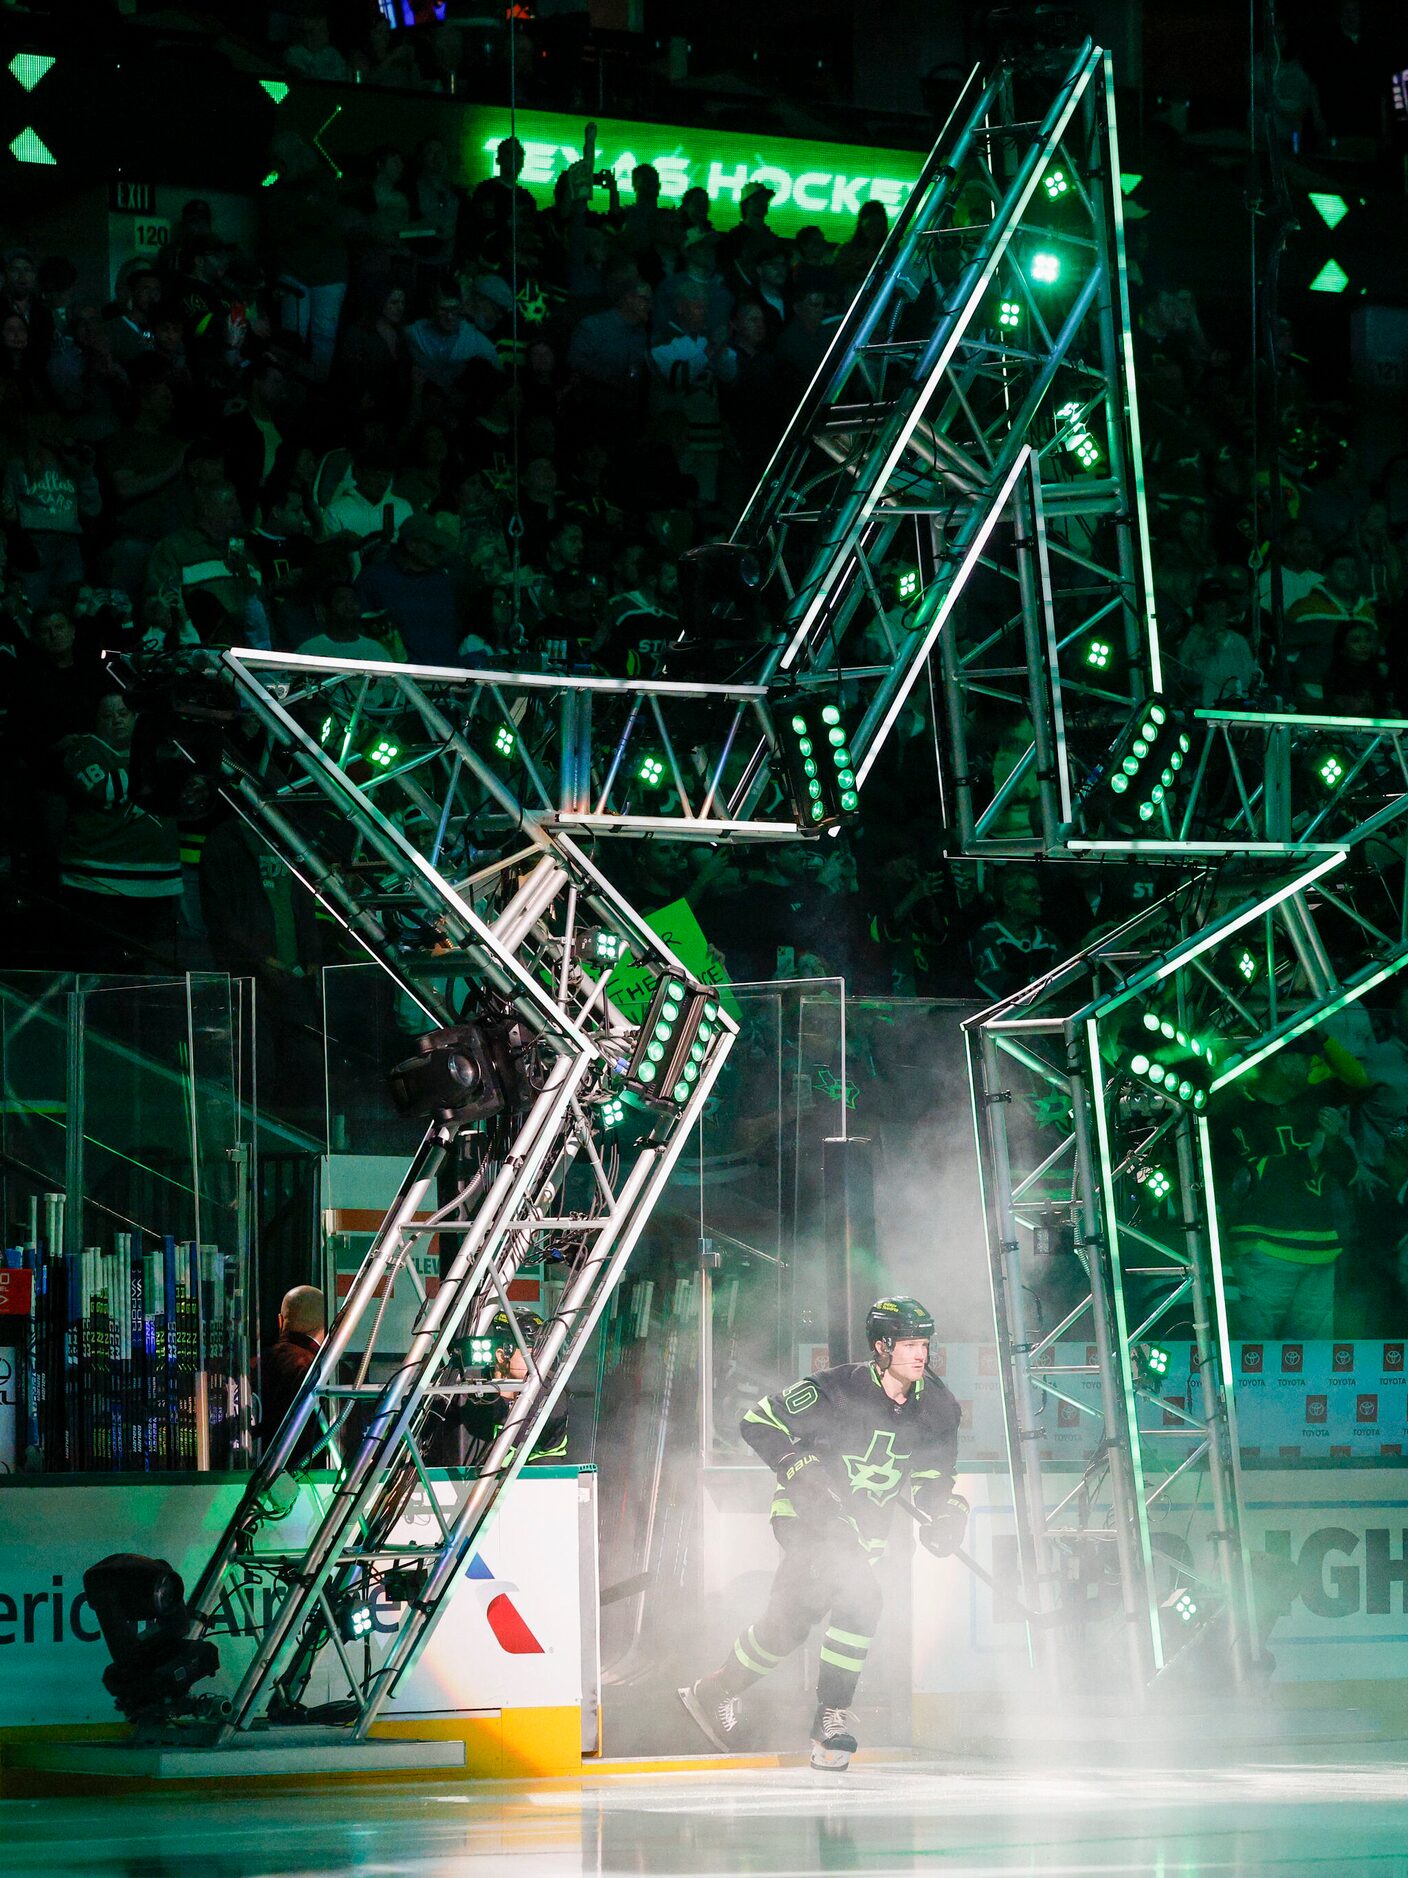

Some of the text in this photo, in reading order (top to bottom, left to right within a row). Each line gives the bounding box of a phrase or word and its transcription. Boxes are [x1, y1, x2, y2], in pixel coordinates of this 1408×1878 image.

[116, 181, 150, 210] EXIT
[137, 226, 168, 246] 120
[1238, 1379, 1266, 1387] TOYOTA
[1278, 1379, 1305, 1387] TOYOTA
[1329, 1378, 1356, 1386] TOYOTA
[1379, 1377, 1406, 1385] TOYOTA
[1302, 1429, 1330, 1437] TOYOTA
[1353, 1428, 1380, 1436] TOYOTA
